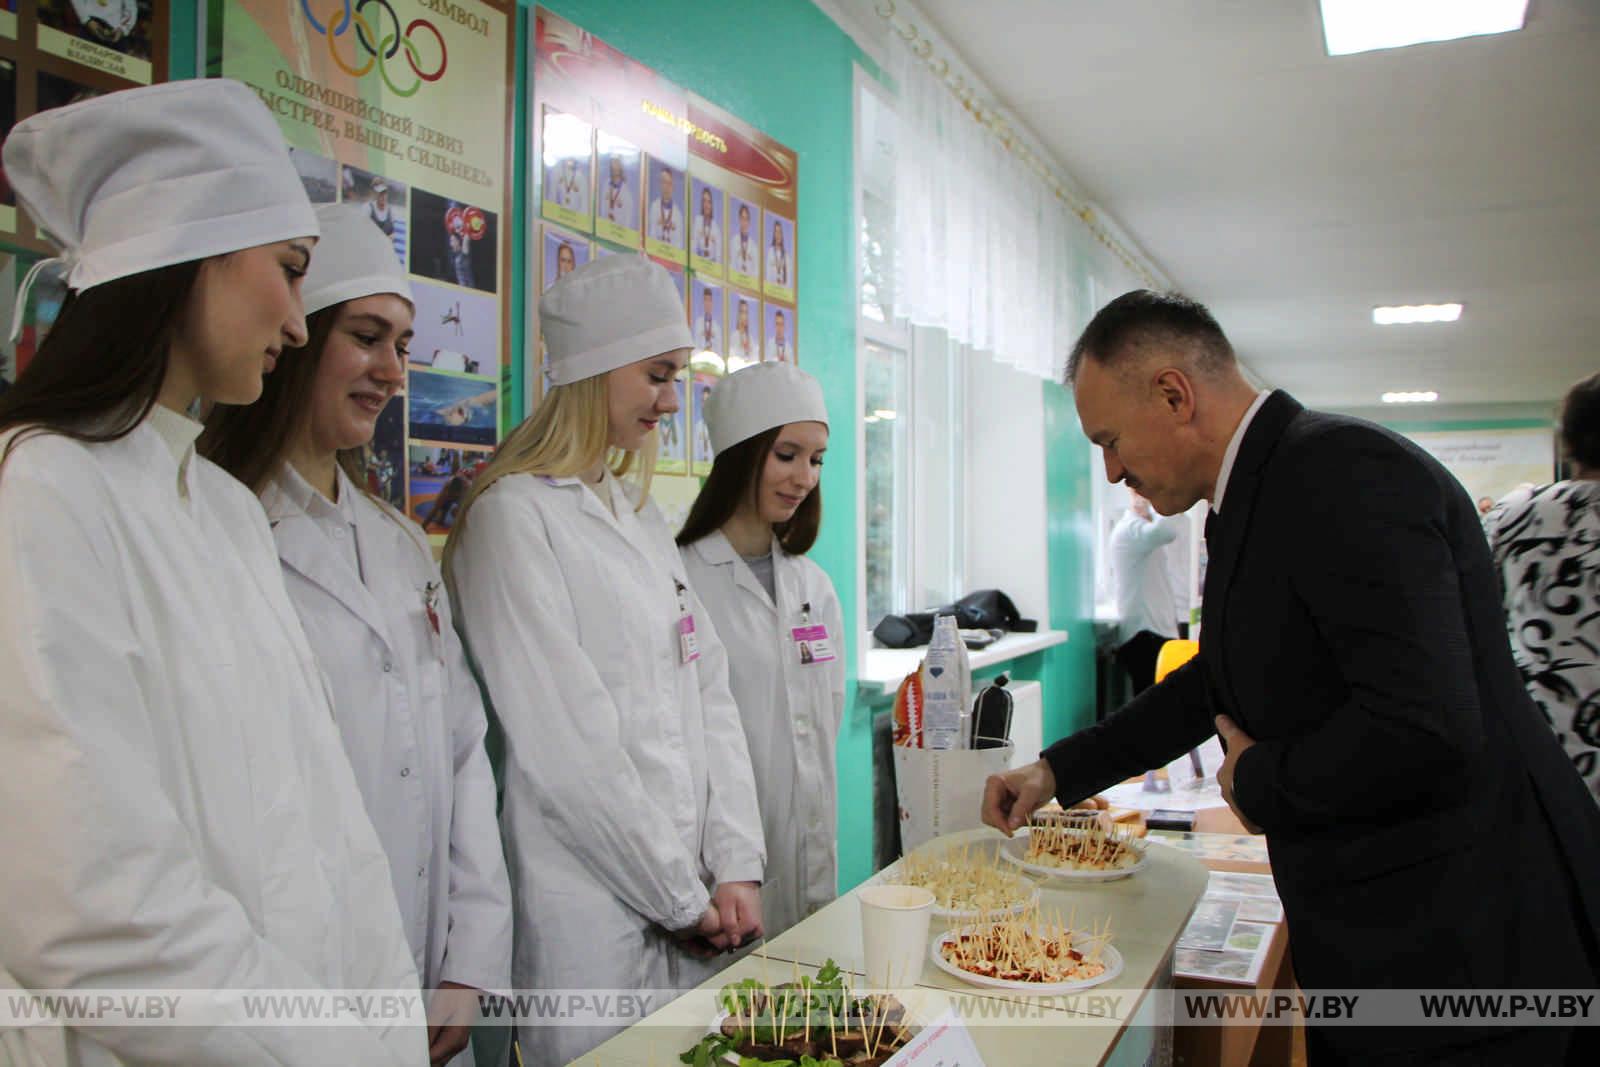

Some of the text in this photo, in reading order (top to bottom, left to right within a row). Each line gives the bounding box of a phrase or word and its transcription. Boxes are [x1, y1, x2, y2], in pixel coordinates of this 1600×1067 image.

[244, 81, 340, 138] ЫСТРЕЕ,
[343, 121, 404, 160] ВЫШЕ,
[275, 69, 465, 155] ОЛИМПИЙСКИЙ ДЕВИЗ
